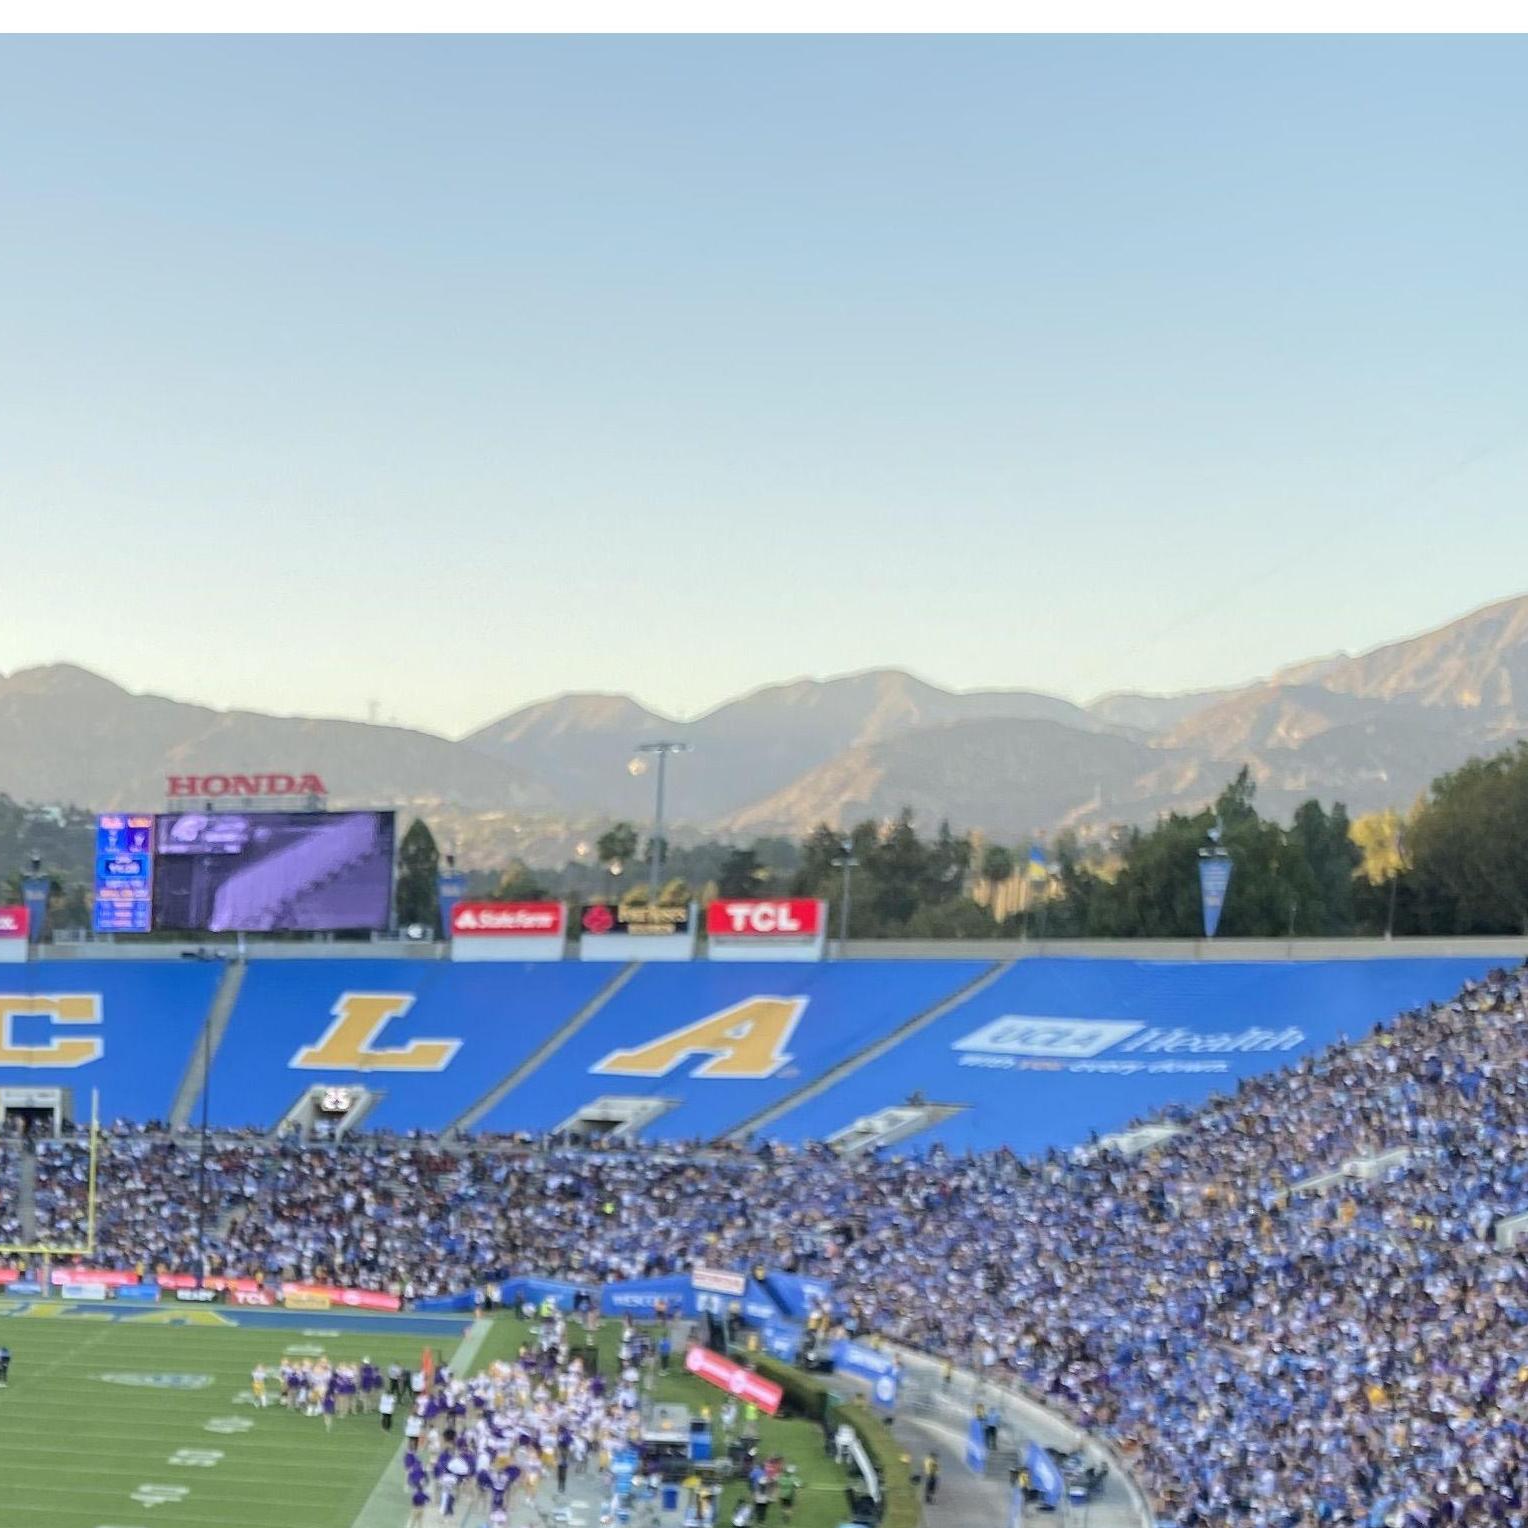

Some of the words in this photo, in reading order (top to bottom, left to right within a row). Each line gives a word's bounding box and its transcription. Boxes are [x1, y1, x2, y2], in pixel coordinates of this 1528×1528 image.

[167, 774, 327, 796] HONDA
[726, 904, 799, 931] TCL
[1122, 1026, 1306, 1052] Health
